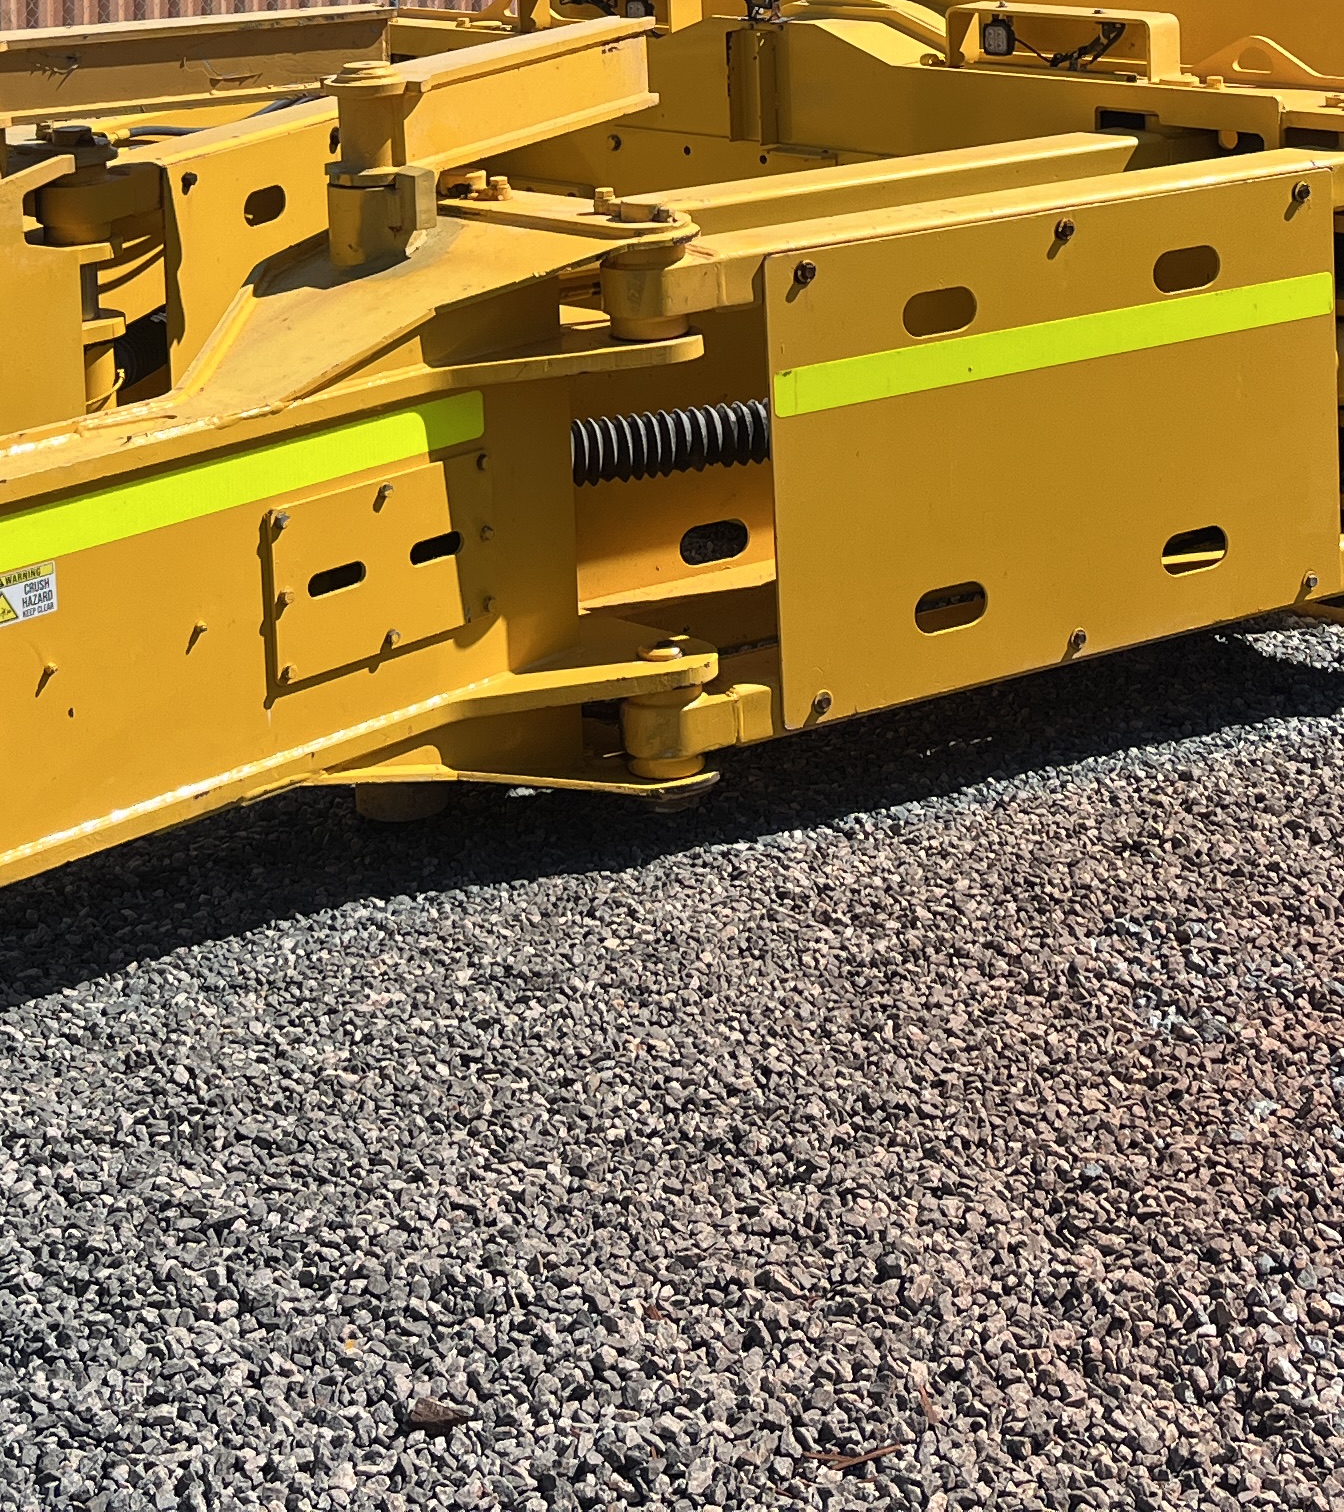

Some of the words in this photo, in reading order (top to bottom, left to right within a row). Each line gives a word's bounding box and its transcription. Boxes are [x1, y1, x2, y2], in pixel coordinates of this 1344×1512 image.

[5, 567, 41, 585] WARNING
[24, 577, 50, 595] CRUSH
[22, 589, 53, 608] HAZARD
[23, 607, 36, 617] KEEP
[37, 602, 54, 613] CLEAR
